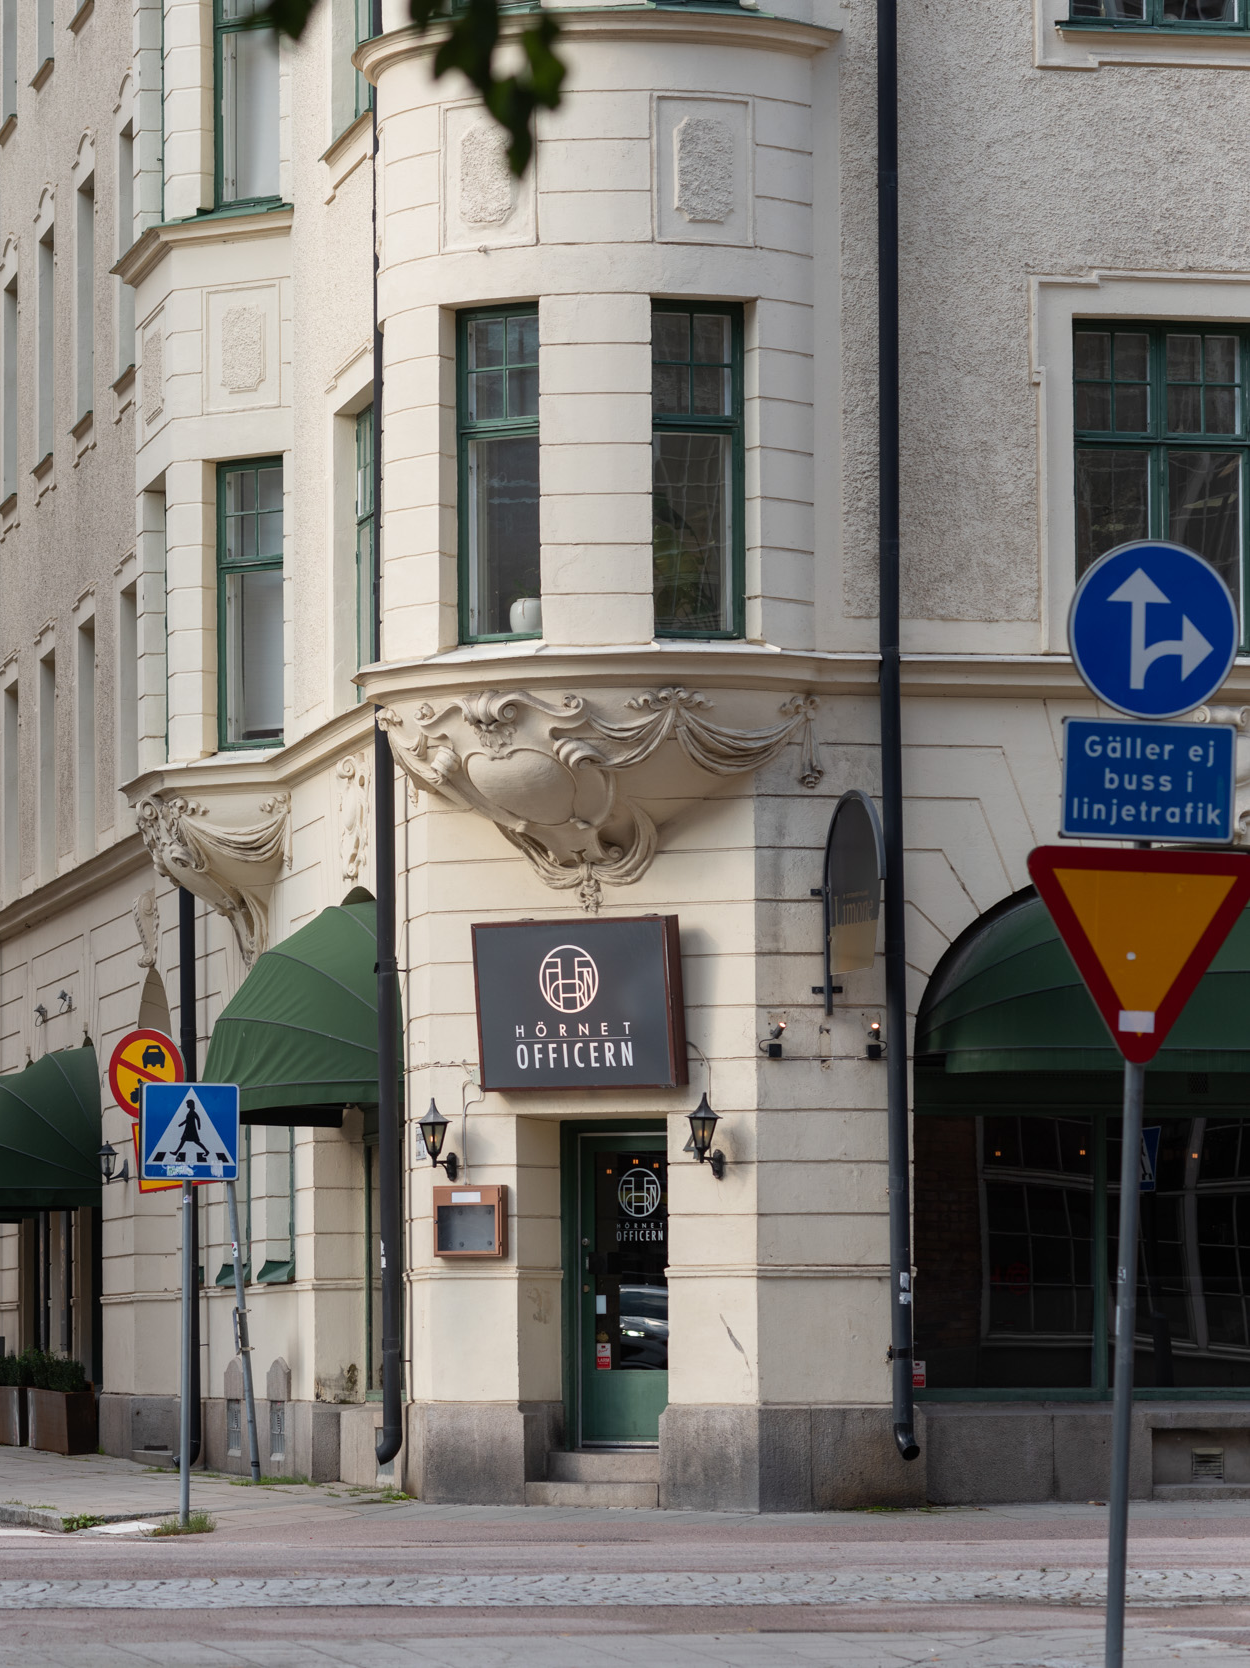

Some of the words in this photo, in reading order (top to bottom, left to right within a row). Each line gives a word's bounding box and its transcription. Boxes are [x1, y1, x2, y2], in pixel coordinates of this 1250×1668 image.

[1084, 735, 1174, 760] Gäller
[1188, 740, 1215, 767] ej
[1104, 767, 1172, 792] buss
[1187, 771, 1193, 793] i
[1072, 797, 1222, 826] linjetrafik
[515, 1021, 631, 1038] HÖRNET
[516, 1041, 634, 1070] OFFICERN
[616, 1230, 664, 1242] OFFICERN
